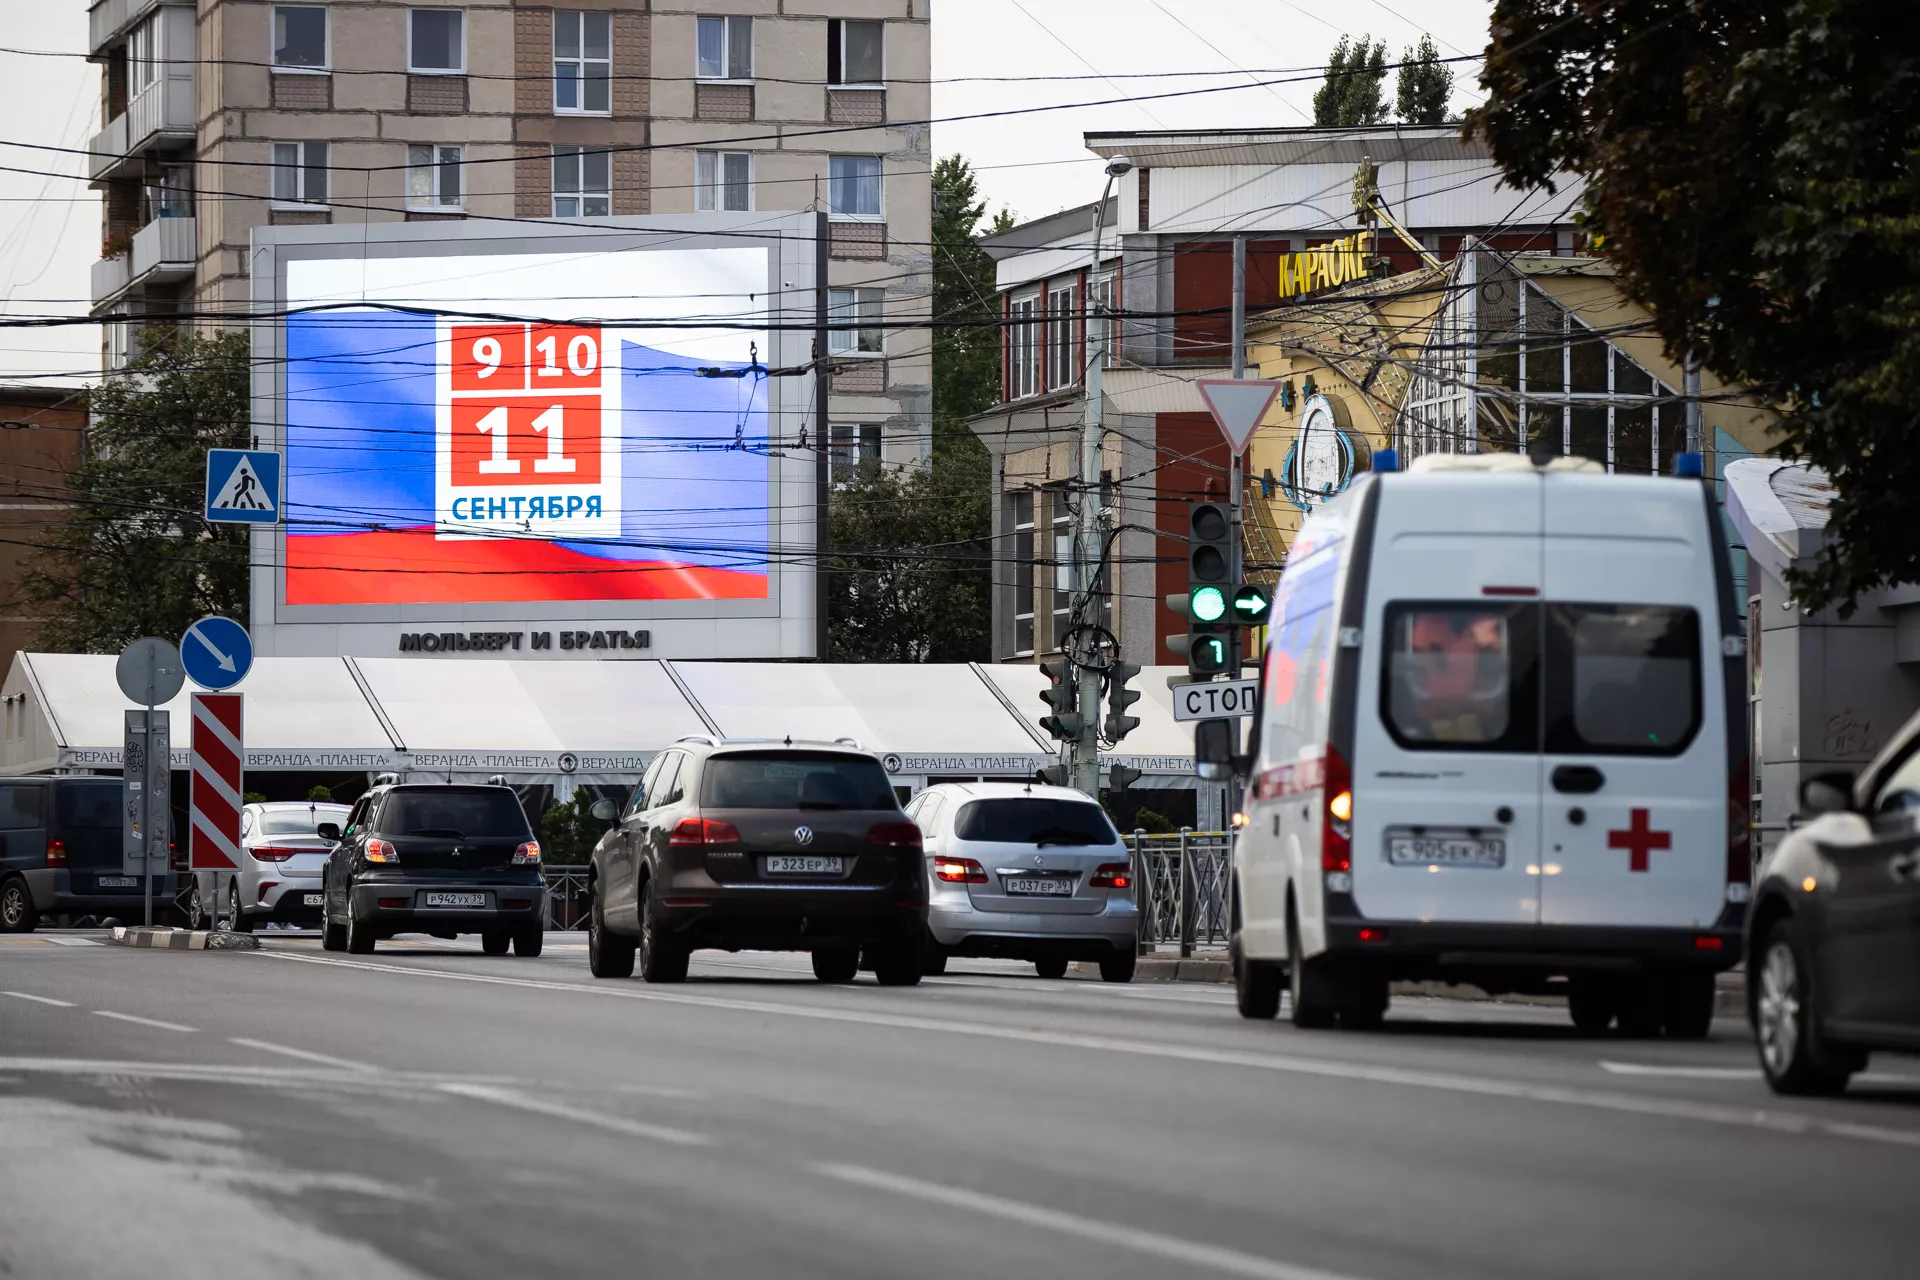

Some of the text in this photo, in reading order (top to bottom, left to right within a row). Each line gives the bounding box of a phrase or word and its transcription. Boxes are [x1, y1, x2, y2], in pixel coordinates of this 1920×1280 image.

[1279, 231, 1374, 298] КАРАОКЕ
[472, 335, 598, 379] 9 10
[475, 404, 577, 475] 11
[452, 495, 602, 520] СЕНТЯБРЯ
[399, 630, 651, 651] МОЛЬБЕРТ И БРАТЬЯ
[1186, 685, 1256, 715] СТОП
[75, 751, 125, 764] ВЕРАН
[248, 754, 312, 767] ВЕРАНДА
[415, 754, 478, 767] ВЕРАНДА
[582, 757, 644, 770] ВЕРАНДА
[905, 757, 966, 770] ВЕРАНДА
[772, 857, 822, 871] Р323ЕР
[1011, 880, 1054, 892] Р037ЕР
[430, 894, 470, 905] Р942УХ
